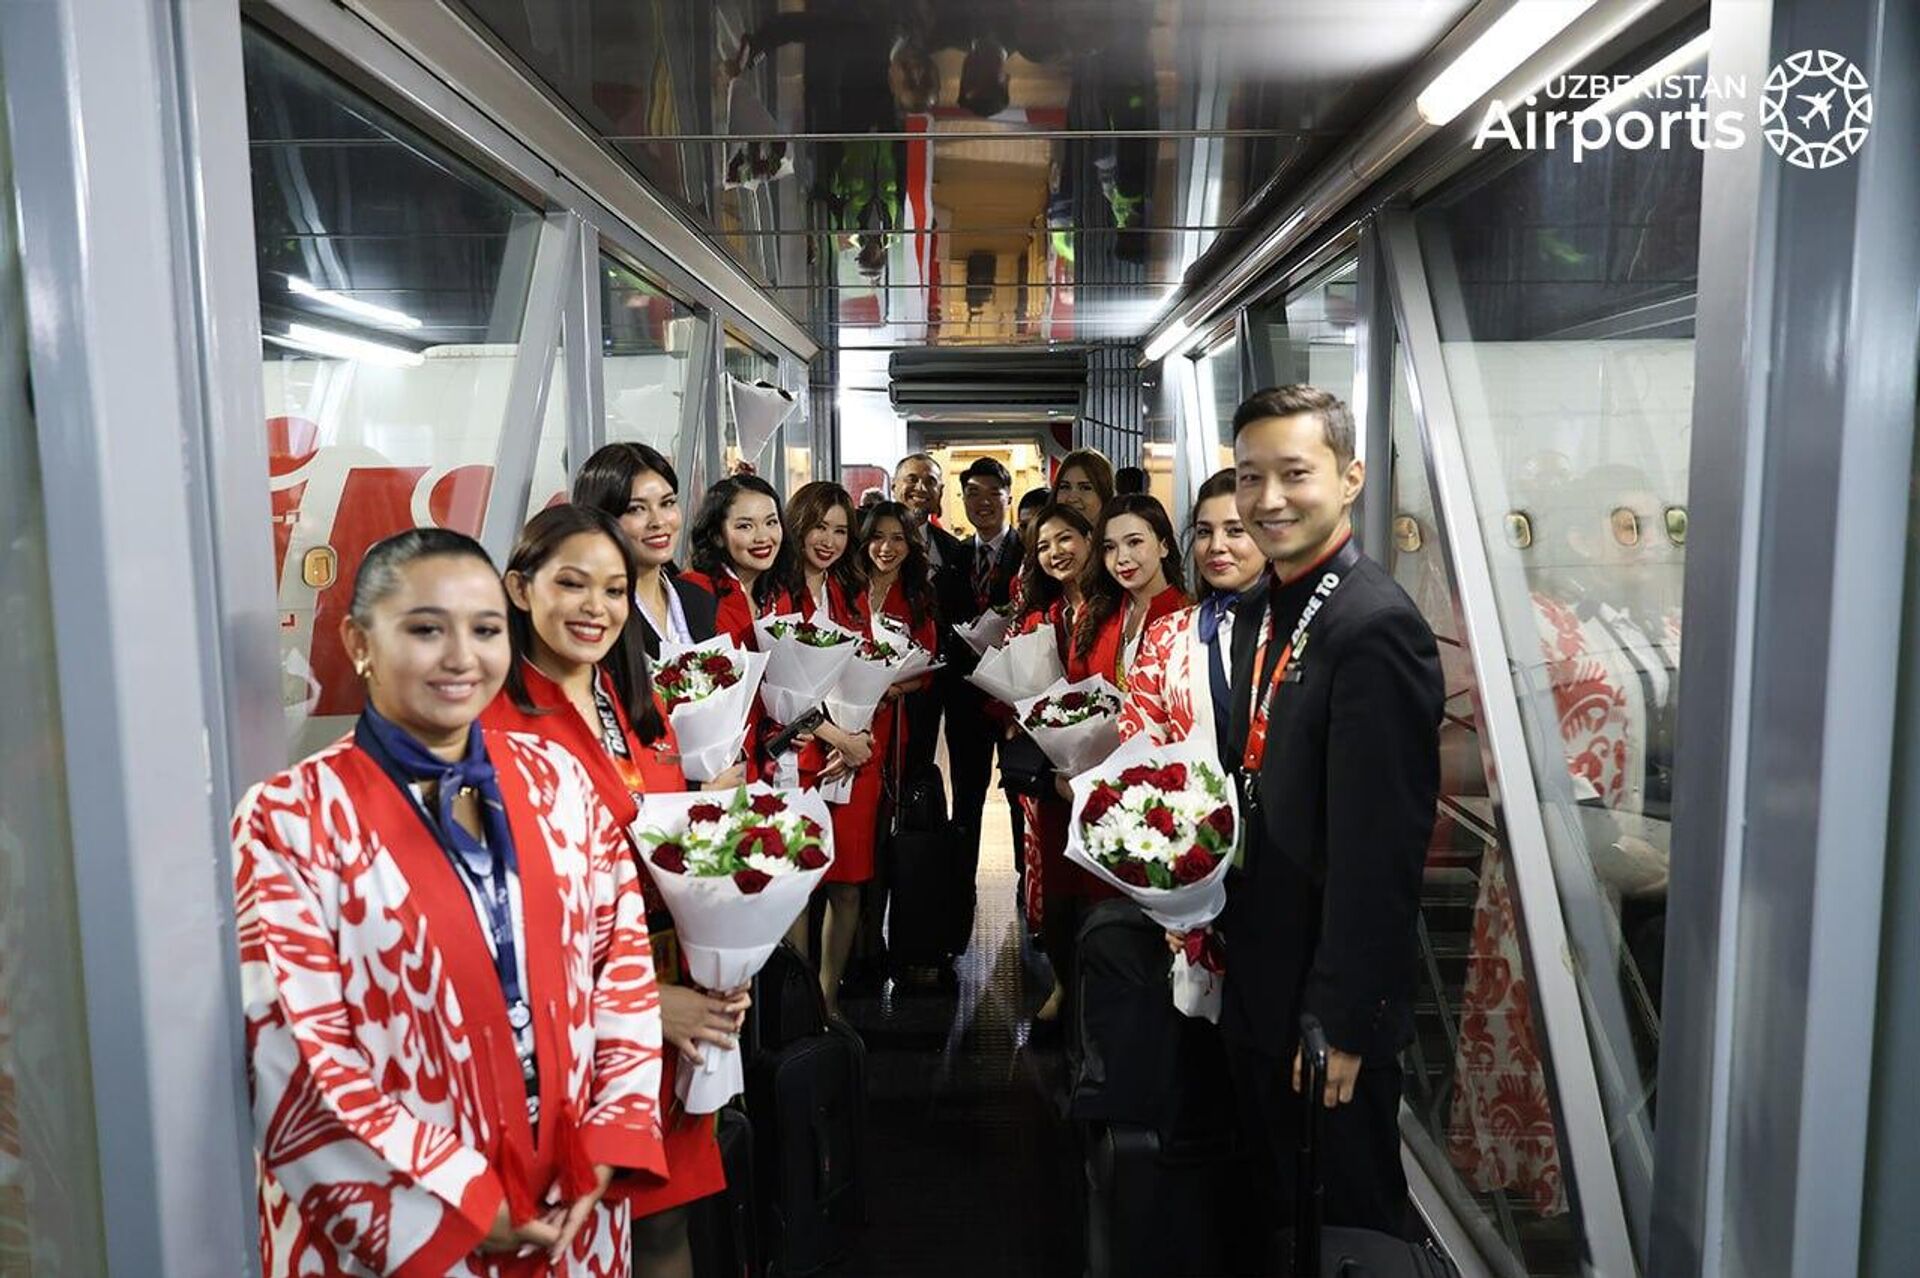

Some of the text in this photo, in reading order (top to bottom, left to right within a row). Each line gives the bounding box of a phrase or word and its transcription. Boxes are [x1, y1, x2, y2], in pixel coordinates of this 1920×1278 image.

[1291, 572, 1340, 646] DARE TO
[600, 710, 627, 754] DARE
